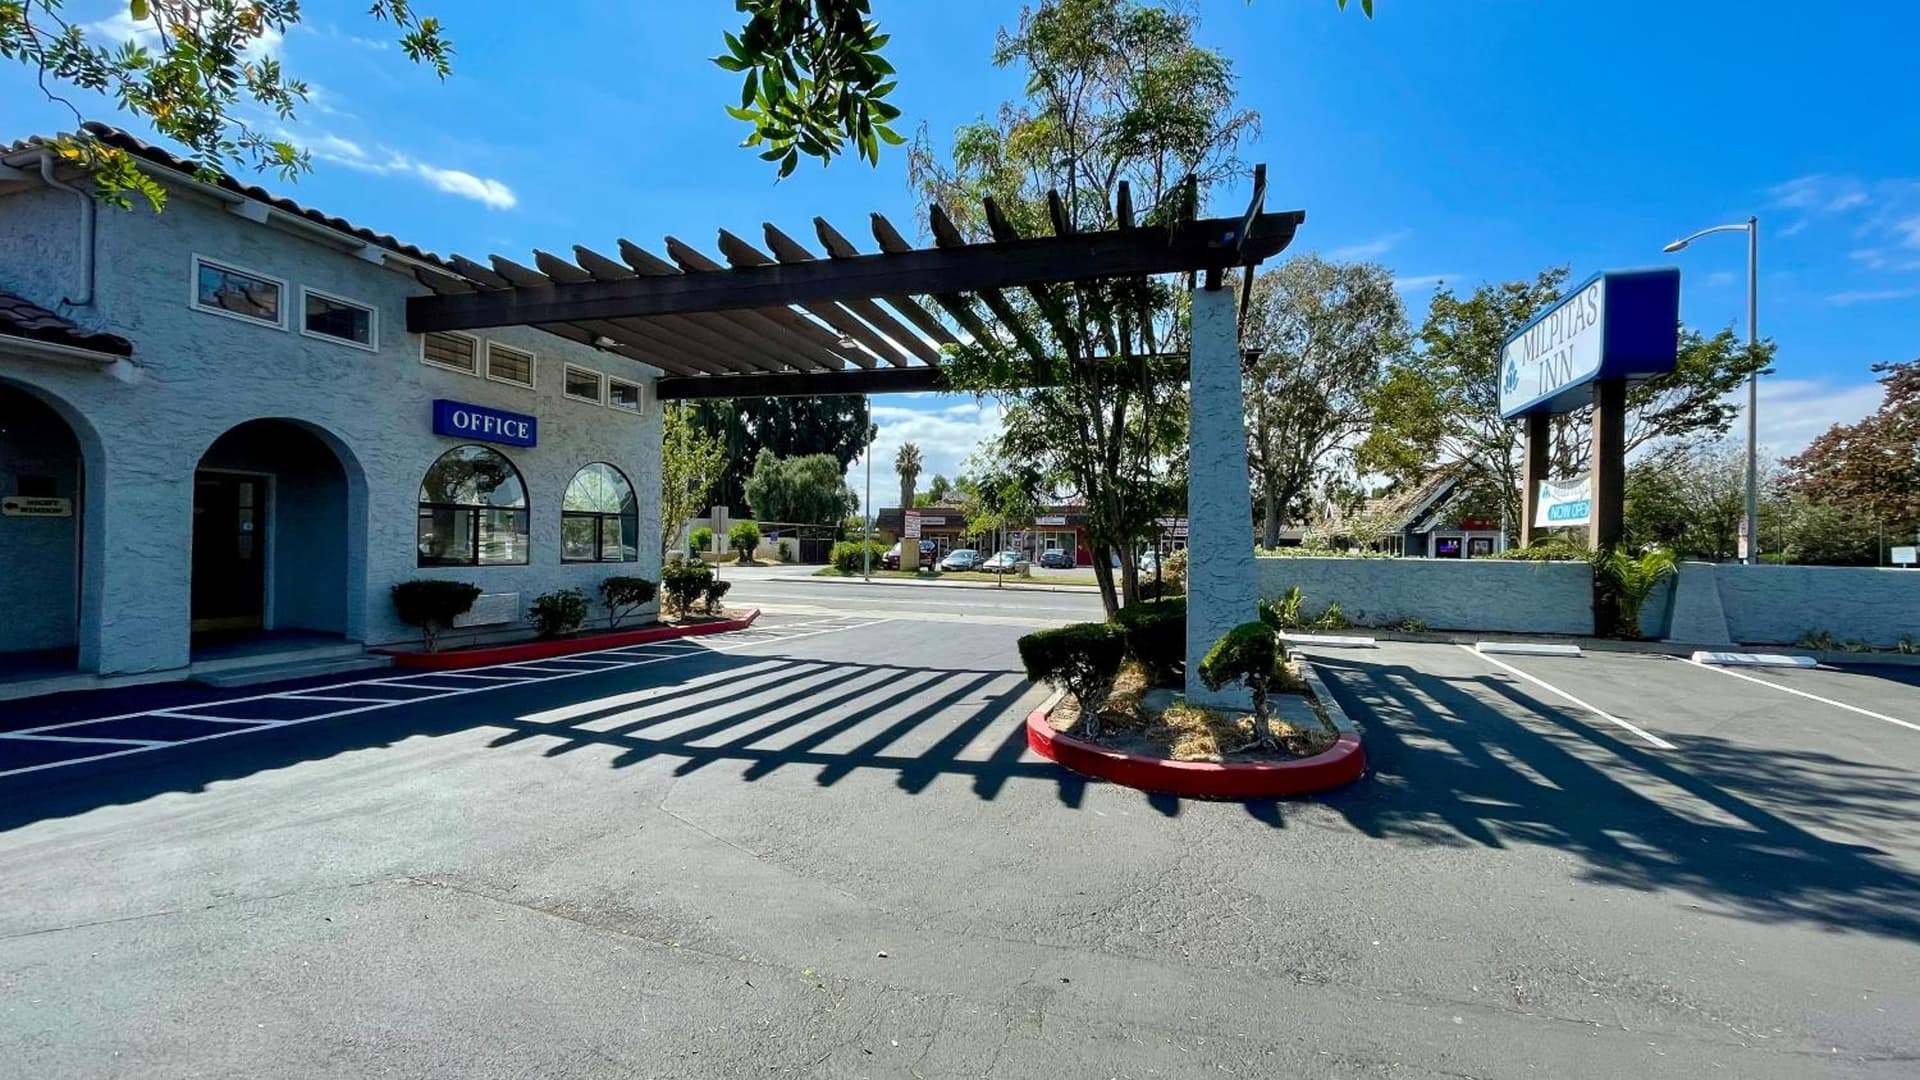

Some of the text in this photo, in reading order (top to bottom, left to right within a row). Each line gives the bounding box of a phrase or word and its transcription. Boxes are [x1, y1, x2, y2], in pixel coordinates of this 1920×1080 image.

[1522, 284, 1598, 367] MILPITAS
[1538, 344, 1575, 396] INN
[452, 410, 529, 439] OFFICE
